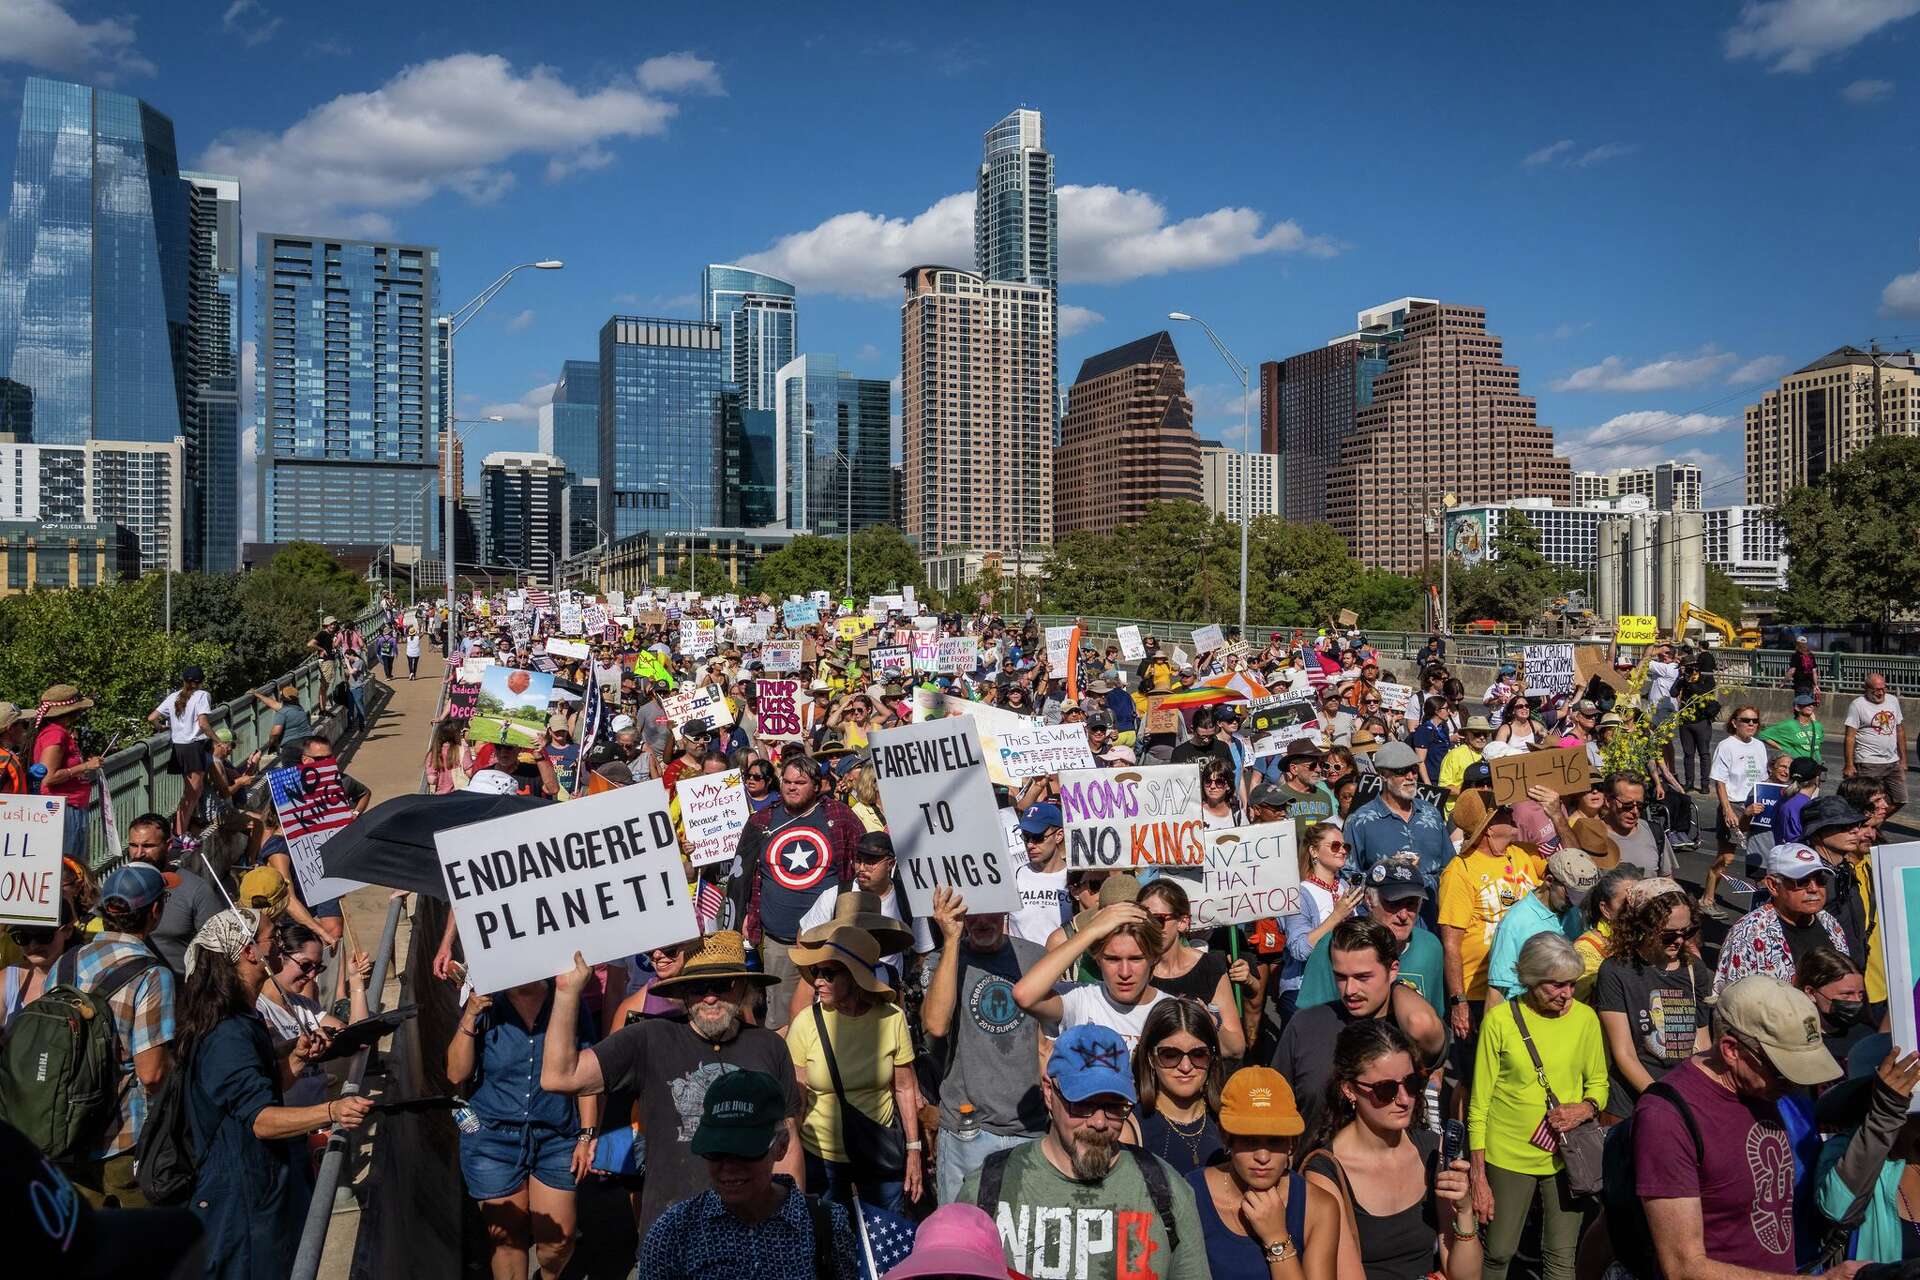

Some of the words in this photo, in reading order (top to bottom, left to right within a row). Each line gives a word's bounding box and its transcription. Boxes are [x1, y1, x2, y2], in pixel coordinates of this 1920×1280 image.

[681, 621, 692, 630] NO
[1620, 630, 1656, 640] YOURSELF
[1525, 645, 1543, 659] WHEN
[1544, 644, 1574, 659] CRUELTY
[872, 660, 882, 669] WE
[1525, 660, 1553, 675] BECOMES
[677, 691, 696, 702] ONLY
[757, 680, 798, 698] TRUMP
[1282, 690, 1299, 701] FILES
[468, 696, 477, 705] by
[666, 703, 691, 718] LIKE
[690, 696, 712, 710] ICE
[695, 709, 707, 718] MY
[757, 714, 800, 736] KIDS
[998, 733, 1030, 747] This
[1032, 731, 1050, 744] Is
[1048, 728, 1083, 741] What
[871, 733, 980, 780] FAREWELL
[283, 767, 321, 803] NO
[691, 784, 722, 801] Why
[1060, 780, 1140, 823] MOMS
[1144, 777, 1198, 817] SAY
[688, 815, 719, 829] Because
[722, 809, 737, 818] it's
[919, 800, 955, 835] TO
[703, 824, 723, 837] Easier
[727, 821, 742, 830] than
[694, 838, 719, 849] hiding
[1070, 826, 1122, 867] NO
[1130, 820, 1205, 866] KINGS
[445, 810, 674, 901] ENDANGERED
[704, 849, 719, 858] the
[1796, 849, 1815, 862] C
[908, 852, 1001, 890] KINGS
[1203, 865, 1264, 892] THAT
[1, 872, 54, 905] ONE
[970, 976, 991, 1006] Reebok
[978, 1020, 996, 1033] 2015
[996, 1019, 1020, 1034] SUPER
[1665, 1015, 1683, 1023] WOULD
[36, 1052, 49, 1082] THULE
[712, 1101, 731, 1115] BLUE
[732, 1100, 754, 1113] HOLE
